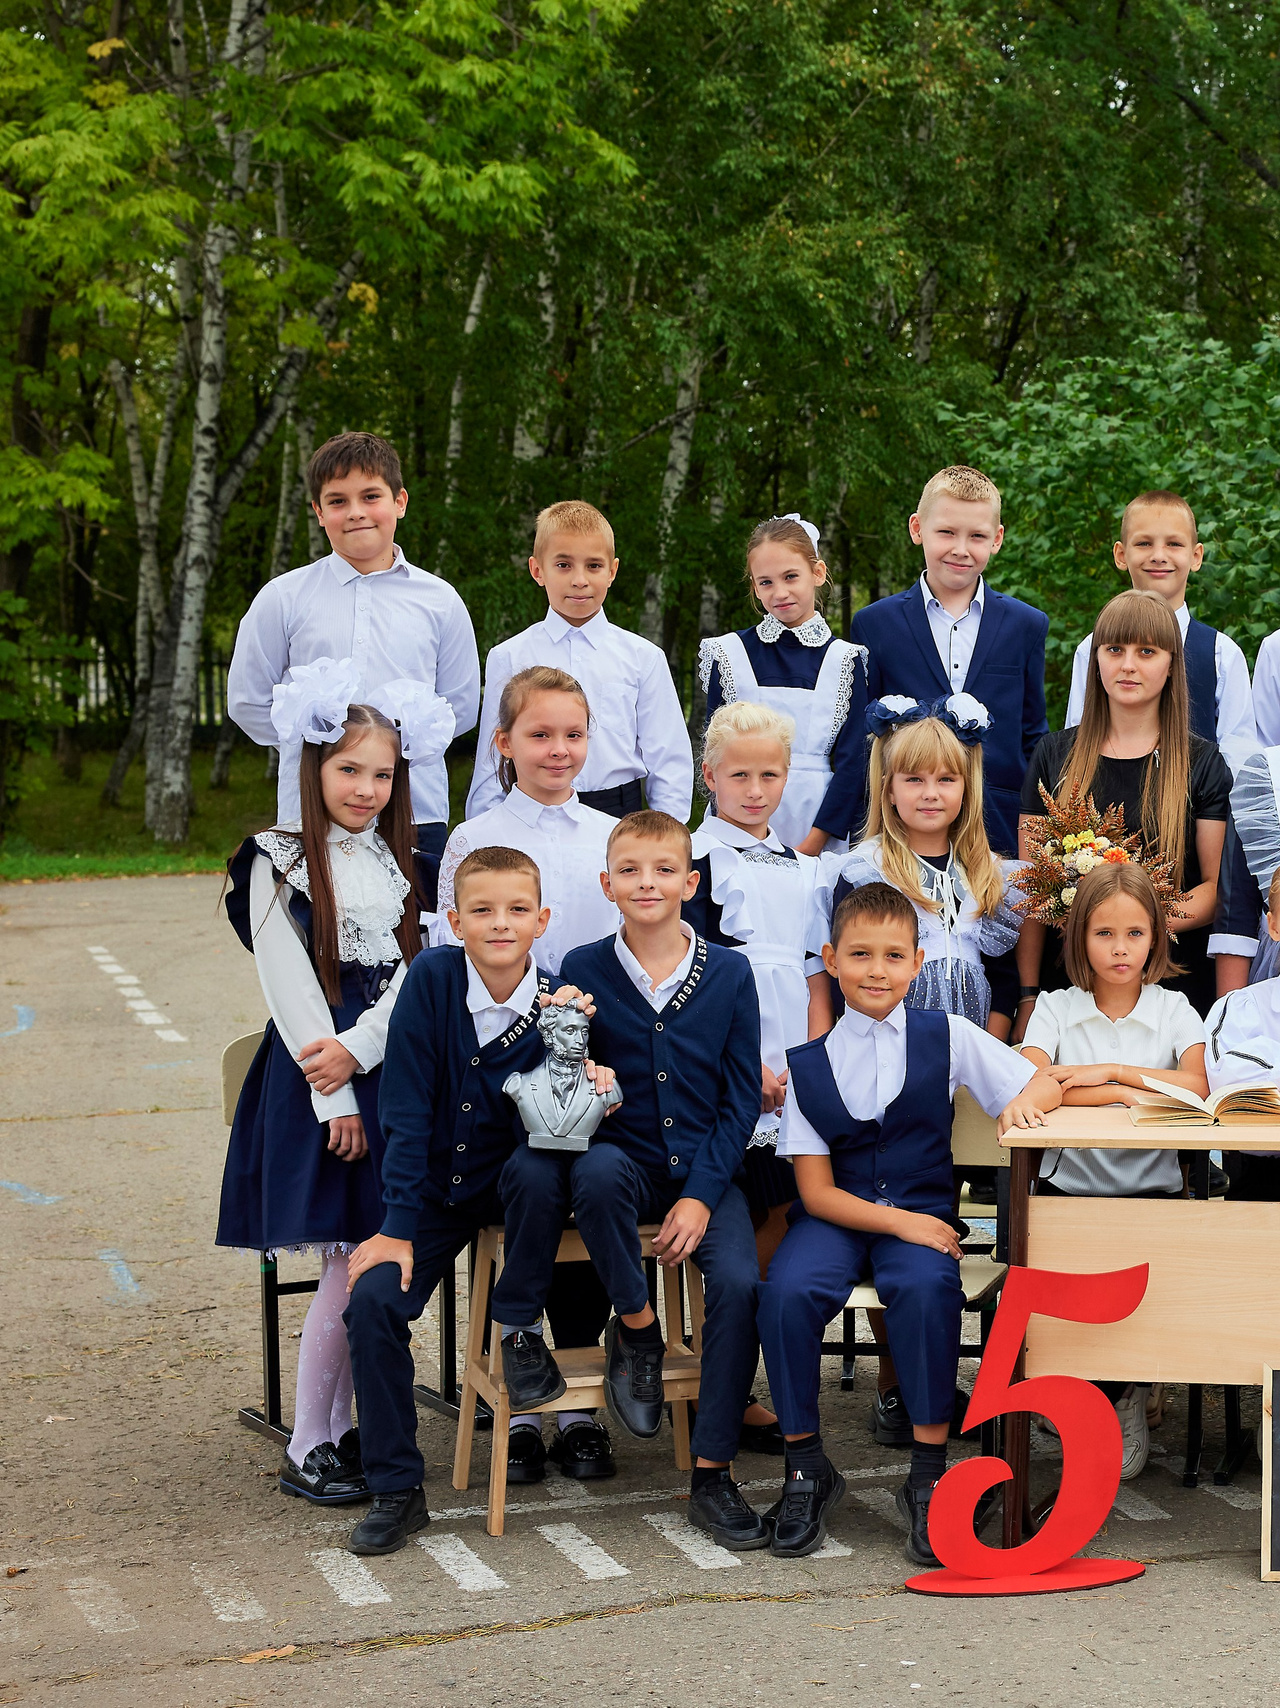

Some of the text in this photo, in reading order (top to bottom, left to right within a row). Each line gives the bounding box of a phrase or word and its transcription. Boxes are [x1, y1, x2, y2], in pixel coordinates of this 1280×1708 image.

[671, 964, 704, 1011] LEAGUE
[500, 1008, 538, 1048] LEAGUE
[927, 1262, 1150, 1579] 5
